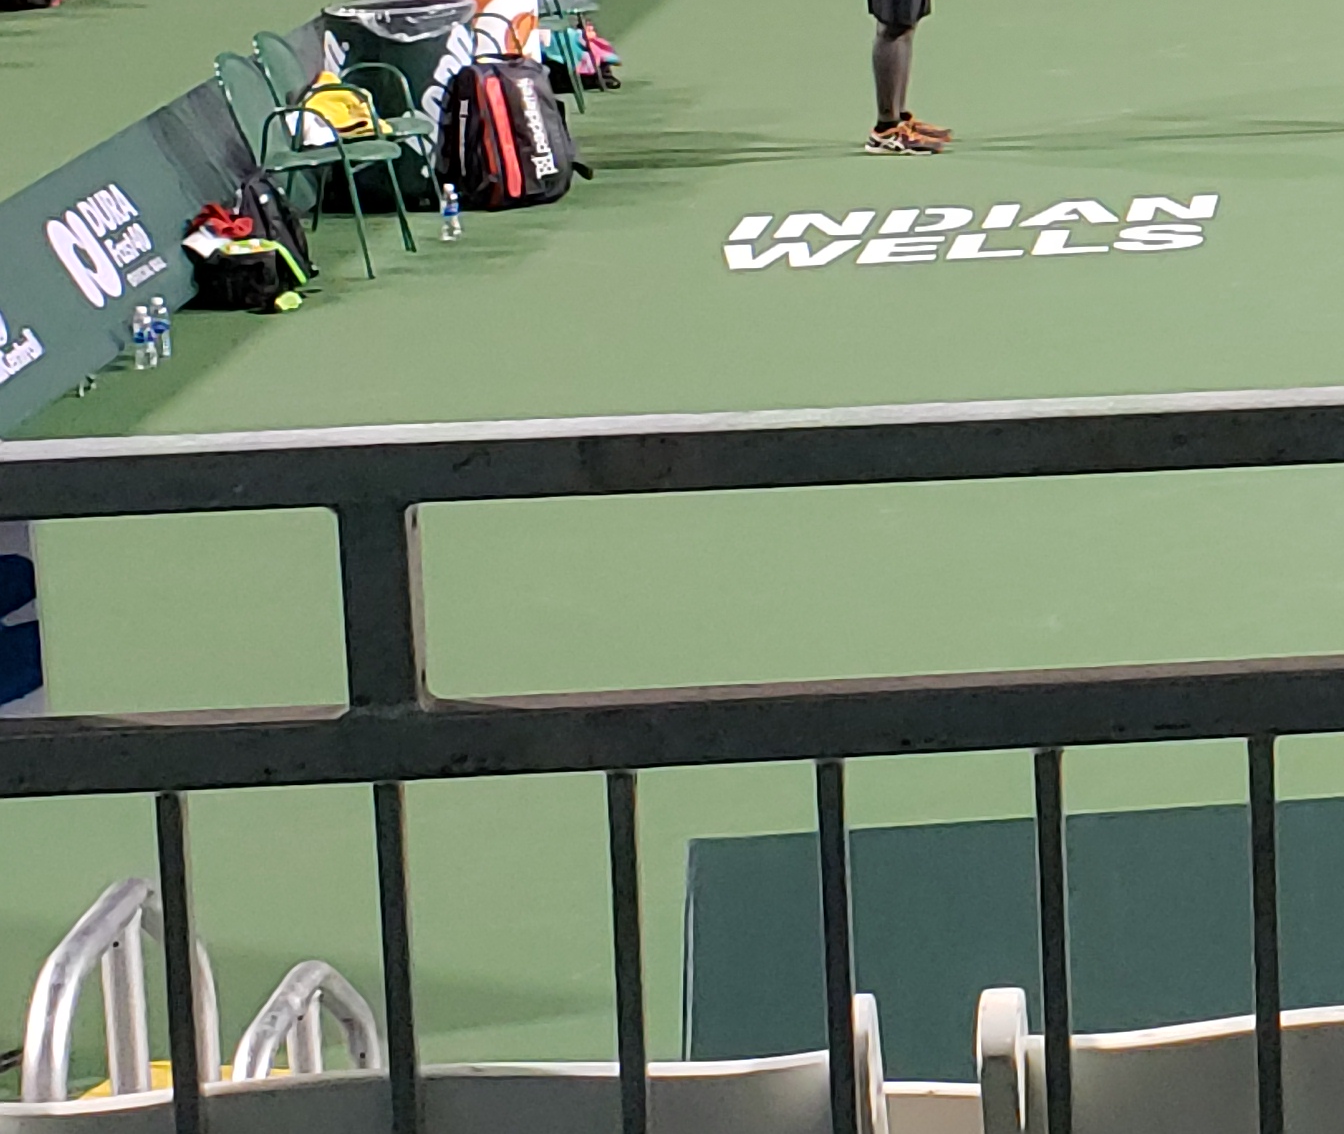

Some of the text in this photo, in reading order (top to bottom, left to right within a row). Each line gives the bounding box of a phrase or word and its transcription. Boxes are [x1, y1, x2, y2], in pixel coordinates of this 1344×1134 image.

[76, 183, 139, 237] DURA
[729, 194, 1218, 240] INDIAN
[724, 223, 1203, 270] WELLS
